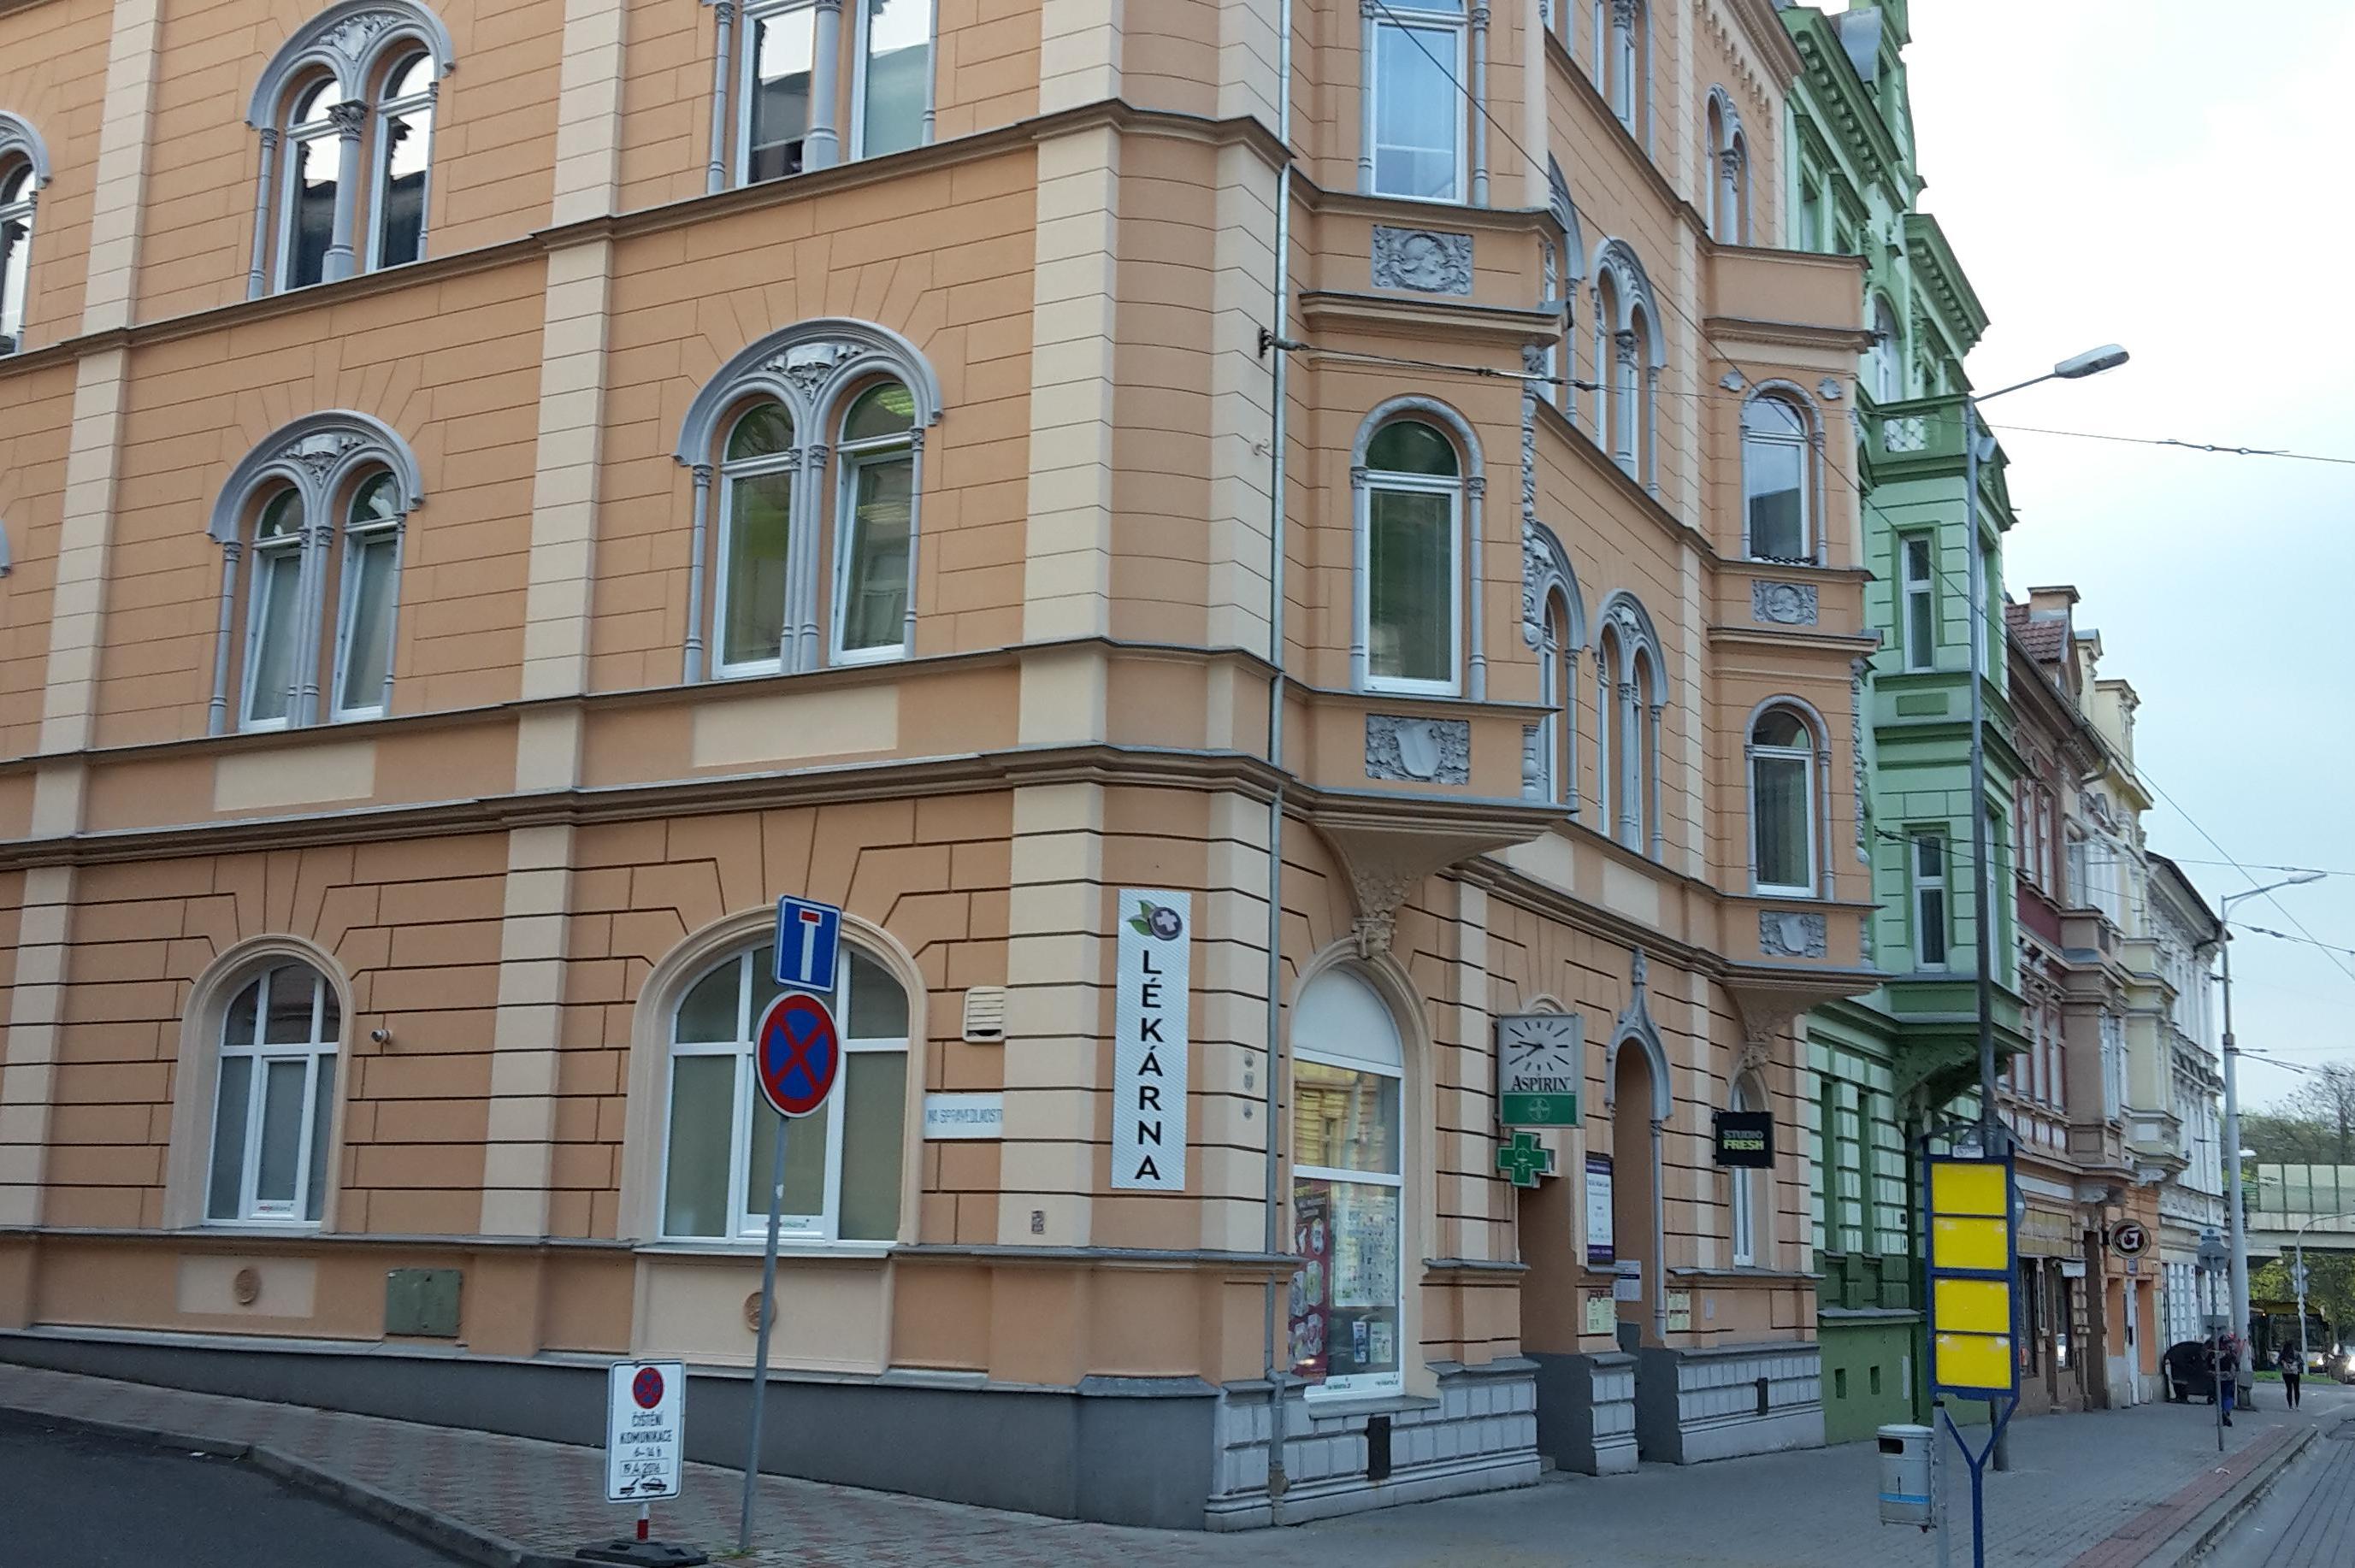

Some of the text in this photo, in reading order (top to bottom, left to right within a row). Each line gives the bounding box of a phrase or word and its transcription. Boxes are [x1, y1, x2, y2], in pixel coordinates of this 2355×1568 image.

[1134, 950, 1164, 1182] LÉKÁRNA
[1511, 1076, 1567, 1093] ASPIRIN
[1723, 1130, 1764, 1140] STUDIO
[1723, 1140, 1765, 1150] FRESH
[632, 1410, 664, 1427] ČIŠTĚNÍ
[619, 1429, 673, 1445] KOMUNIKACE
